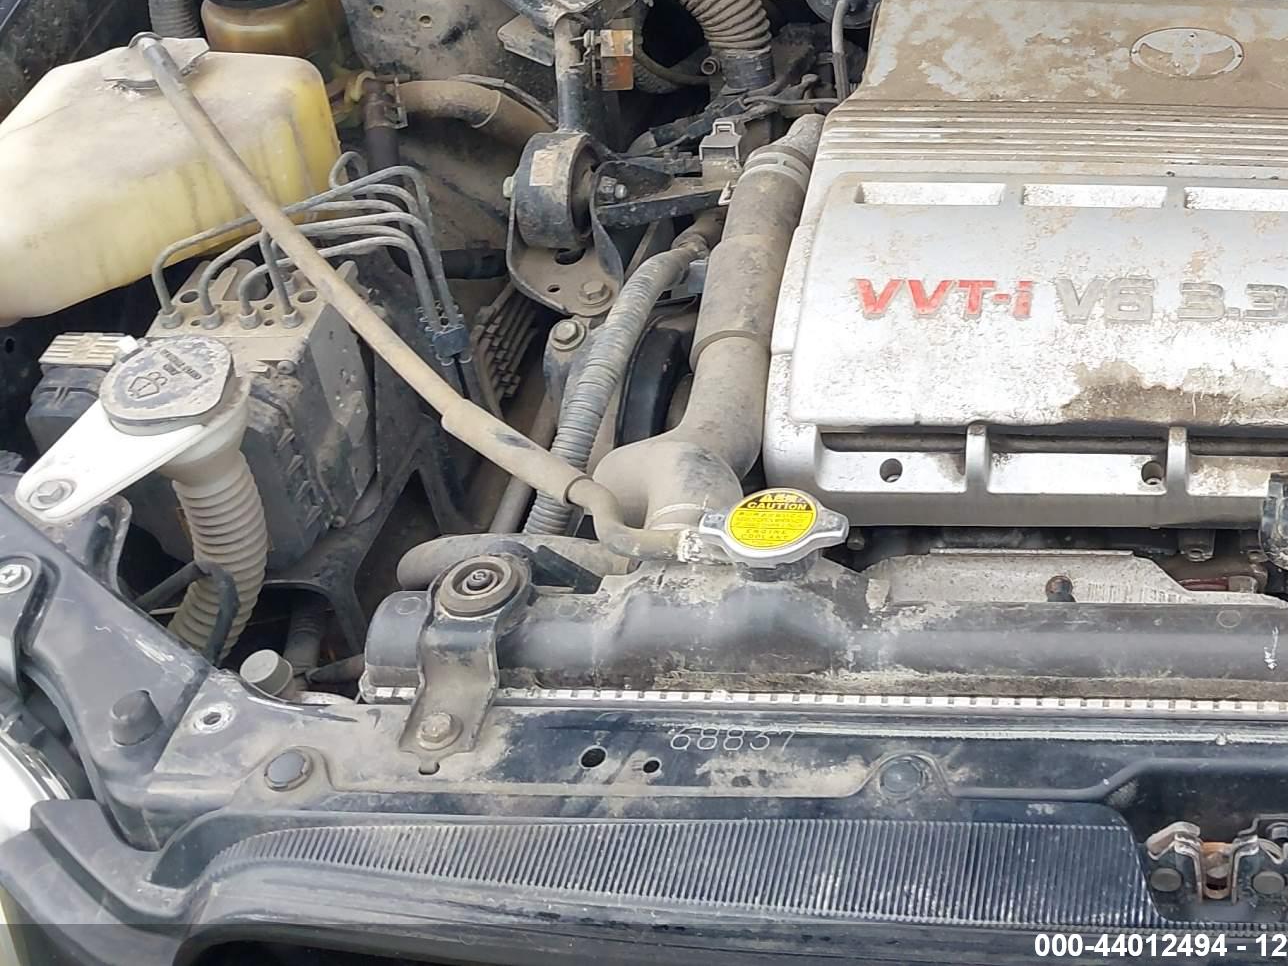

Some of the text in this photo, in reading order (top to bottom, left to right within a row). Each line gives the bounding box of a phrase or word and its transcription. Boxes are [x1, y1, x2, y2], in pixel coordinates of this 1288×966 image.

[854, 278, 1034, 321] VVT-i
[1055, 276, 1157, 325] V6
[747, 501, 808, 511] CAUTION
[670, 725, 796, 752] 68837
